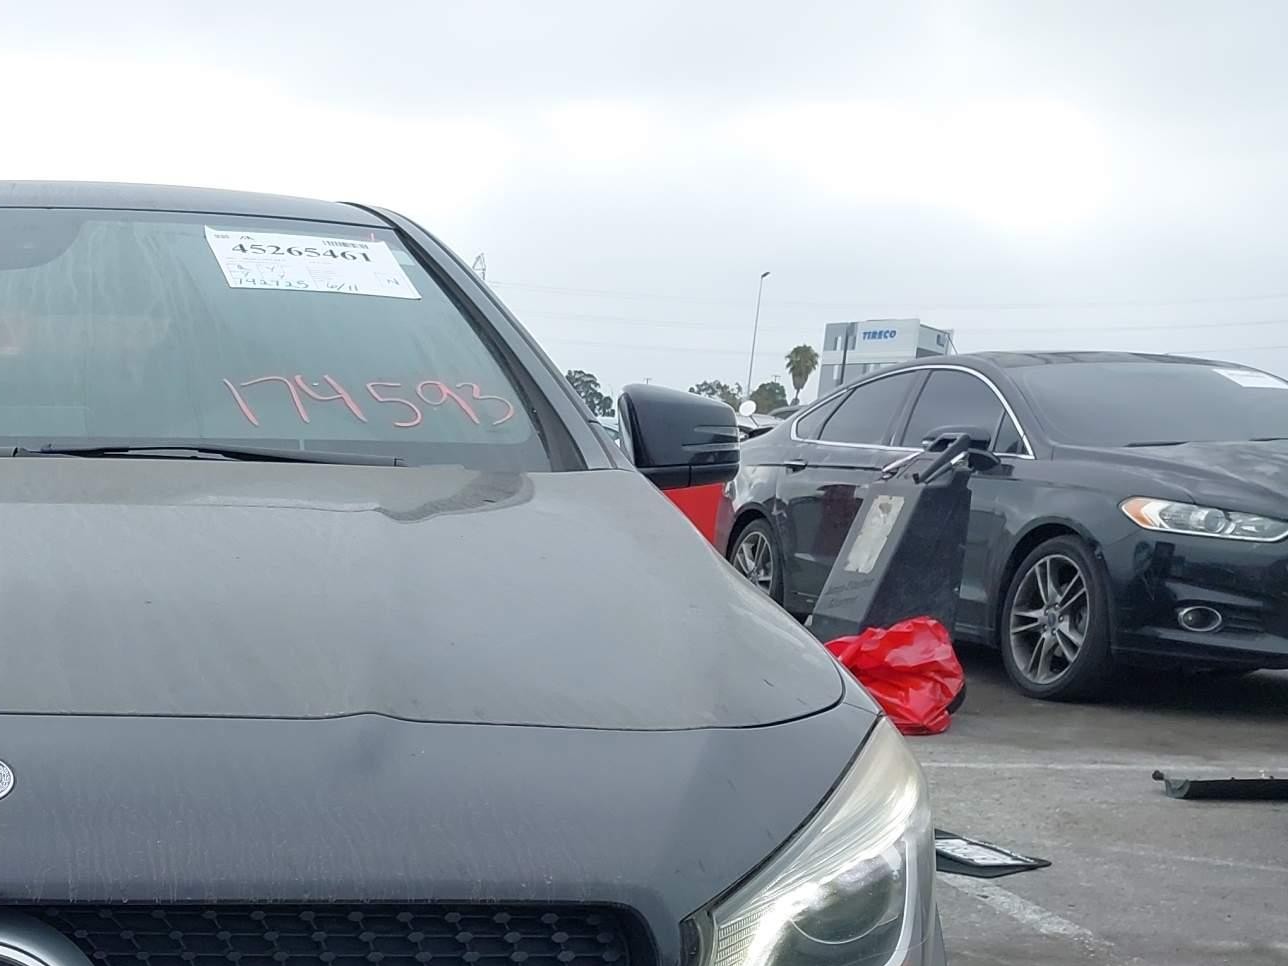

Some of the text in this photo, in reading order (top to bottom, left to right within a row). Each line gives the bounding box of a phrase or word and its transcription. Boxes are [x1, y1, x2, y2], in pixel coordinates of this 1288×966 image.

[231, 243, 372, 263] 45265461
[862, 330, 897, 340] TIRECO
[222, 375, 514, 427] 174593
